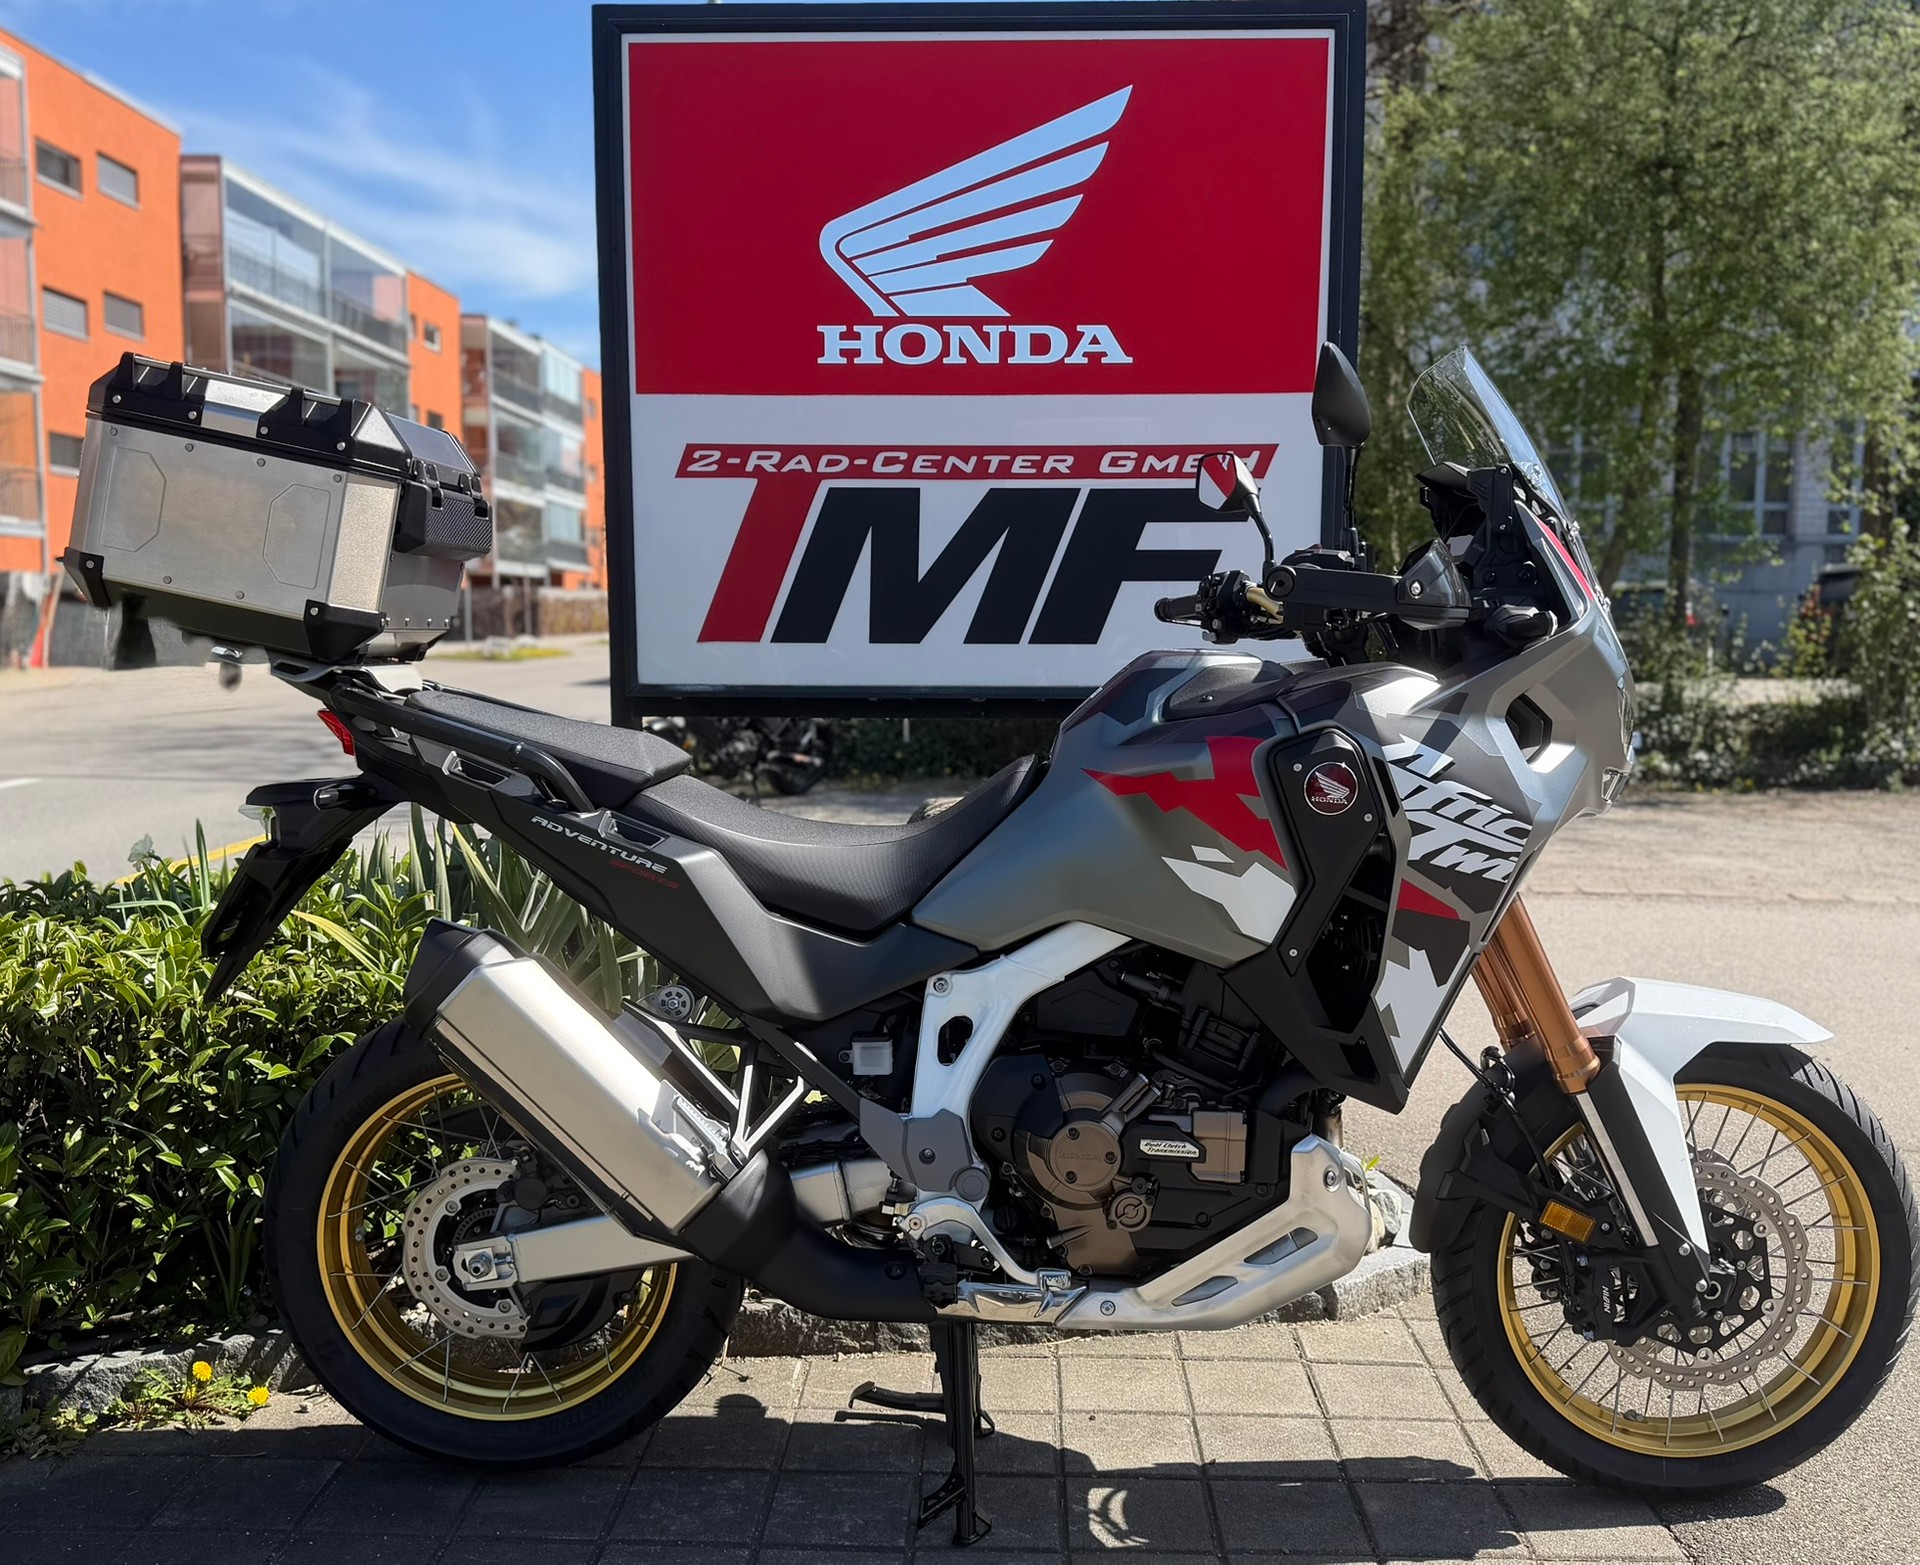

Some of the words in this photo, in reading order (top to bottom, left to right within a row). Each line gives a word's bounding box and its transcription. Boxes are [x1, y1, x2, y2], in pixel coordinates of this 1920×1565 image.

[817, 325, 1133, 364] HONDA
[697, 482, 1259, 644] TMF
[1311, 796, 1349, 805] HONDA
[531, 815, 668, 874] ADVENTURE
